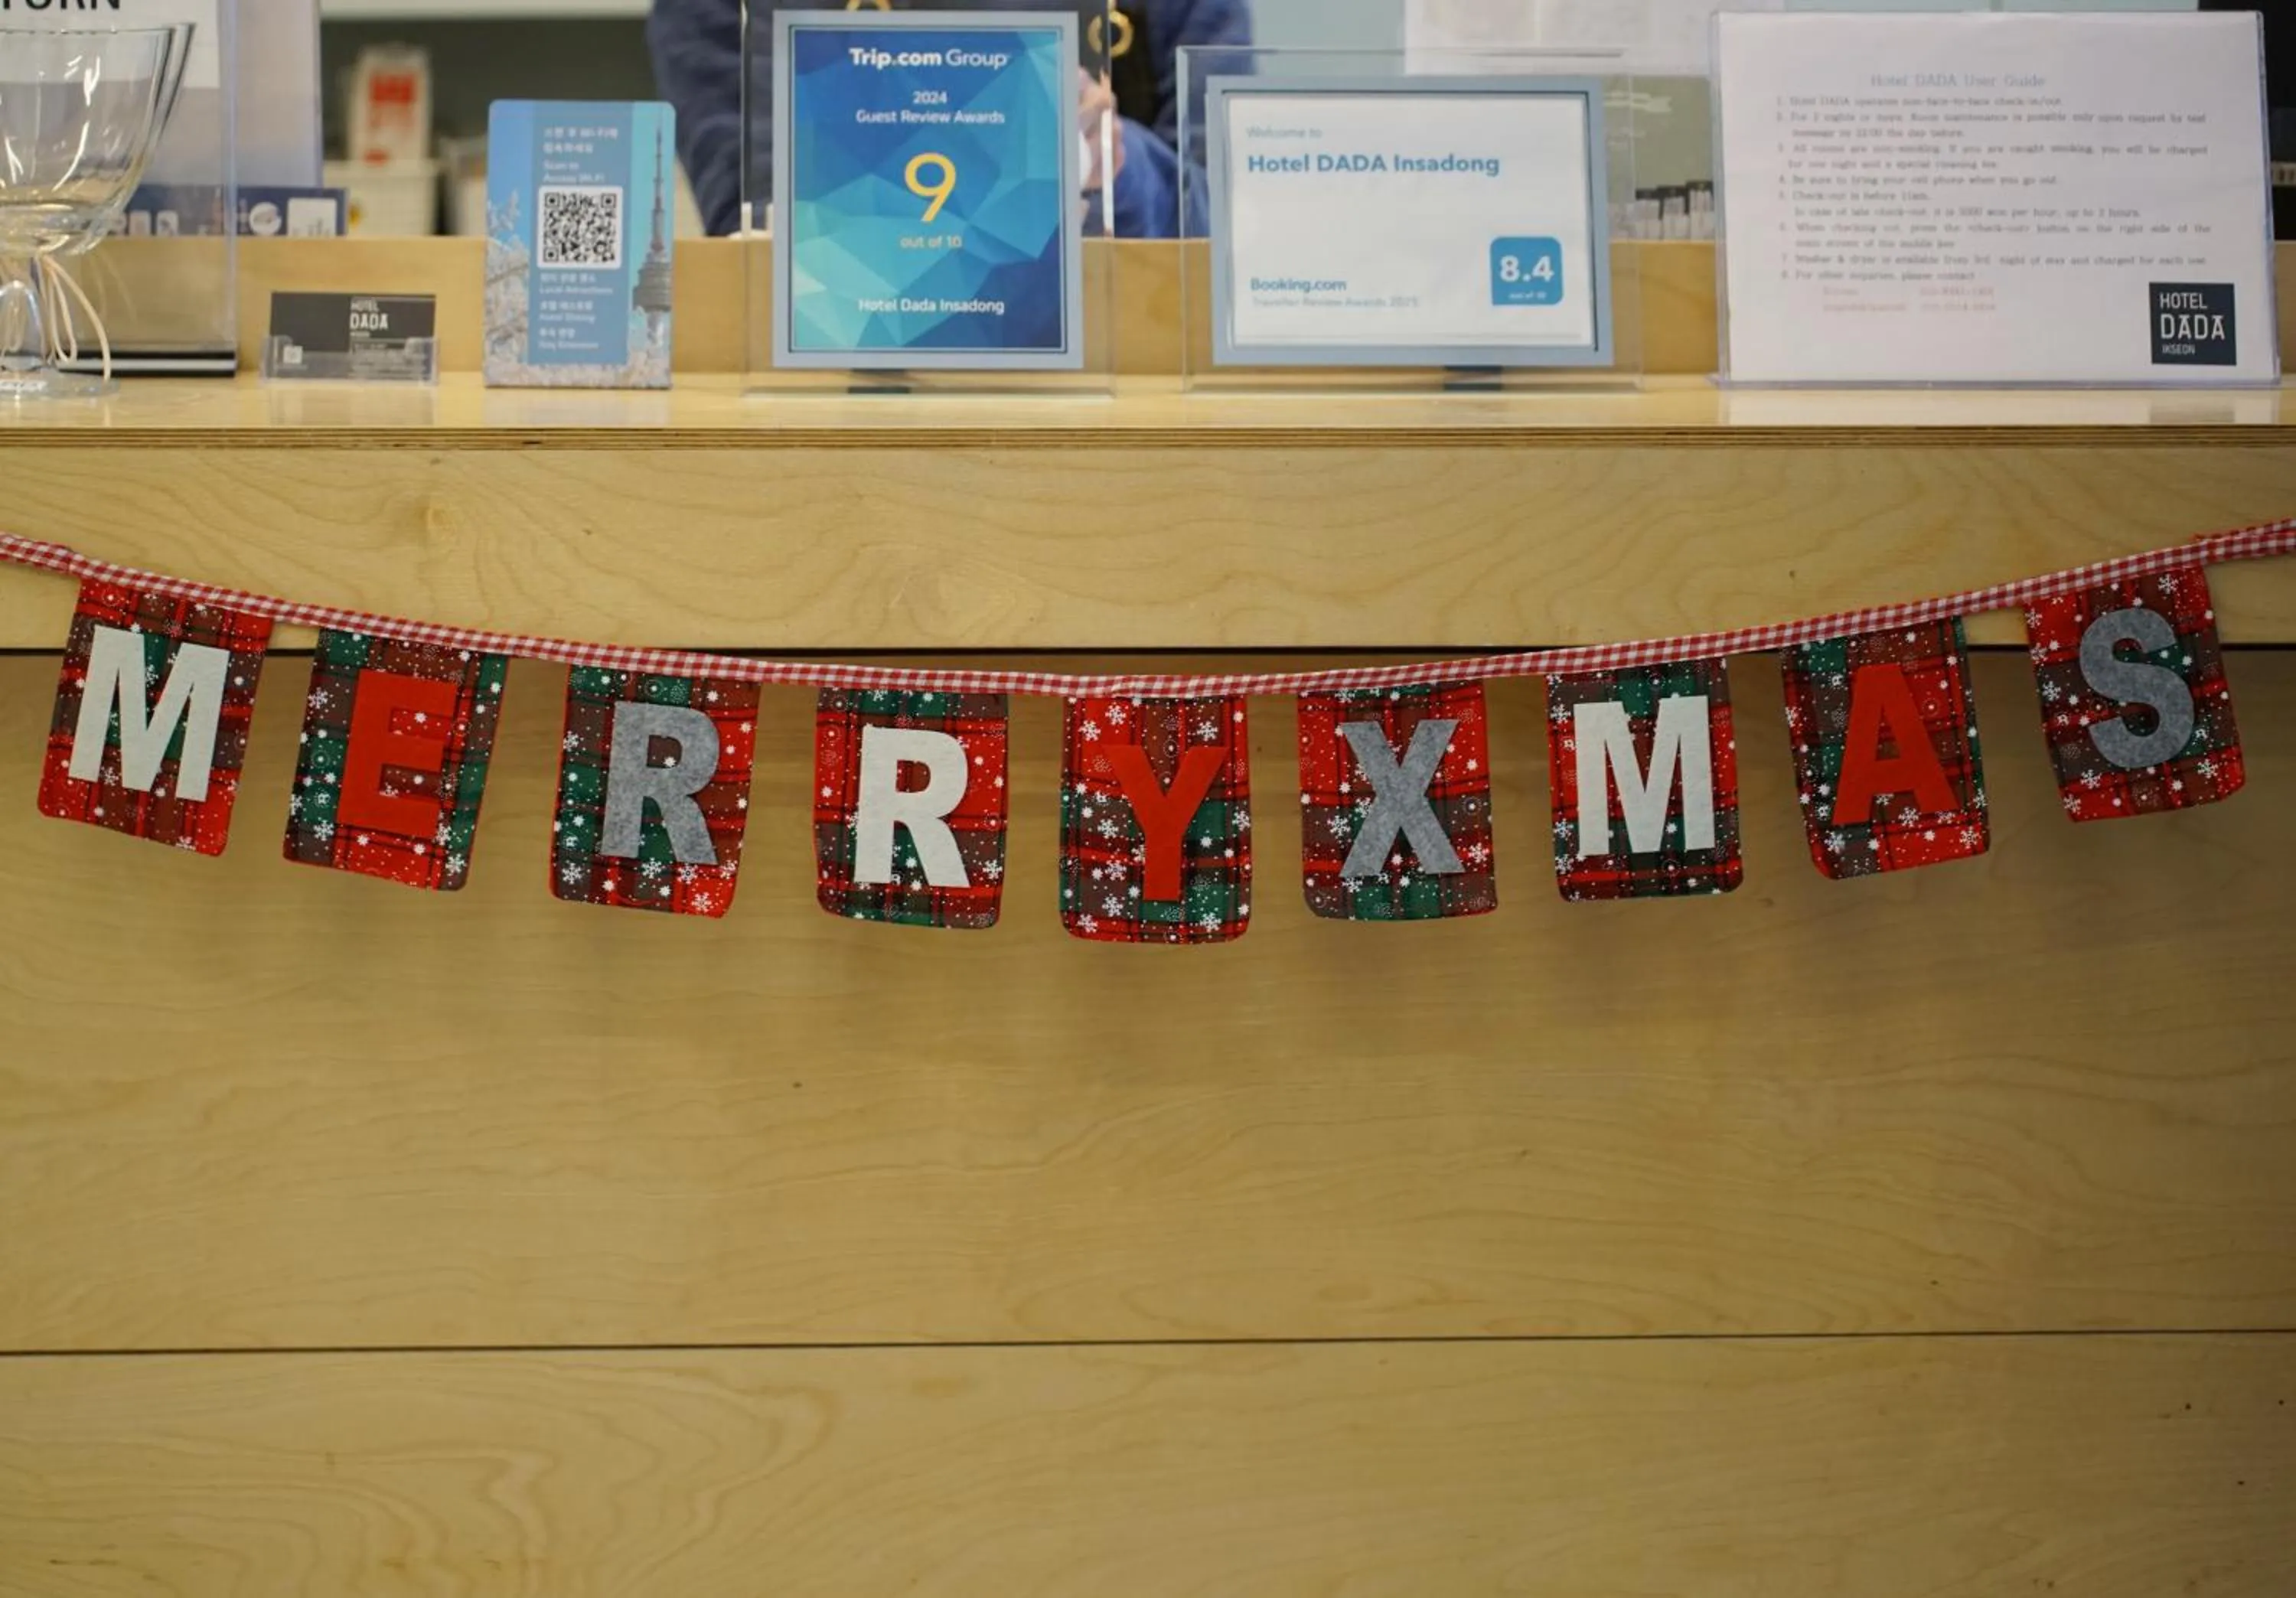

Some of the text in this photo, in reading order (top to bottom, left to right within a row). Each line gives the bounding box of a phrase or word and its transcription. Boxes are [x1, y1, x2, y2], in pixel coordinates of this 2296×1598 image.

[848, 47, 1008, 70] Trip.com Group
[912, 90, 947, 104] 2024
[856, 109, 1006, 123] Guest Review Awards
[1246, 126, 1322, 139] Welcome to
[1247, 153, 1501, 178] Hotel DADA Insadong
[904, 152, 957, 222] 9
[899, 236, 963, 248] out of 10
[1501, 255, 1555, 282] 8.4
[1250, 278, 1348, 293] Booking.com
[858, 298, 1005, 315] Hotel Dada Insadong
[2159, 292, 2208, 309] HOTEL
[350, 312, 389, 331] DADA
[2160, 314, 2226, 341] DADA
